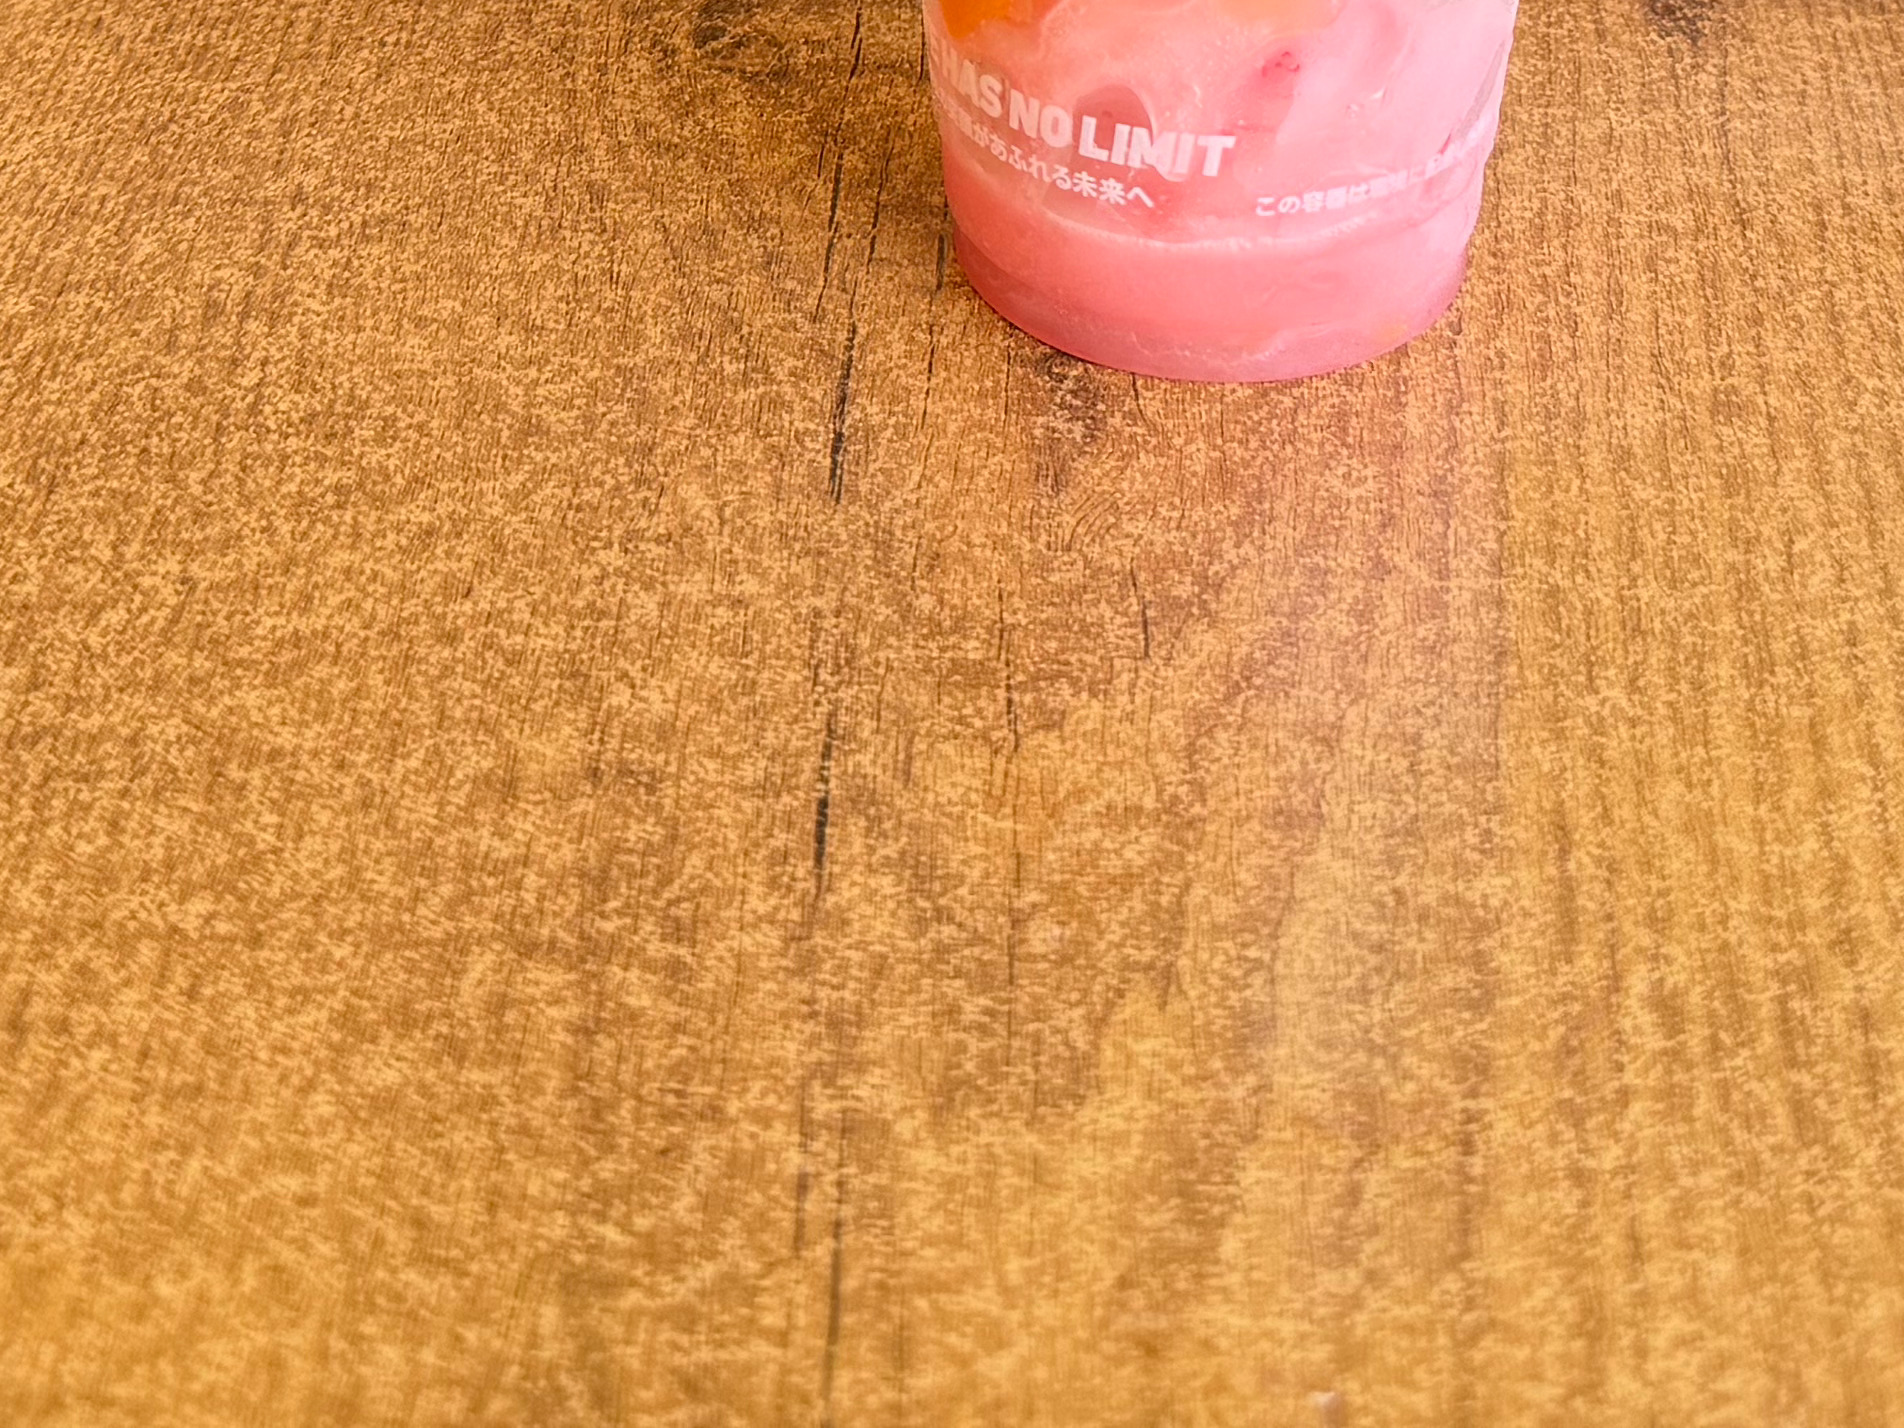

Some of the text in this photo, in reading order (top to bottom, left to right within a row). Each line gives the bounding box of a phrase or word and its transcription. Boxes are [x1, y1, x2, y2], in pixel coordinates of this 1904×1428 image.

[942, 38, 1003, 119] HAS
[1008, 87, 1073, 148] NO
[1078, 114, 1237, 178] LIMIT
